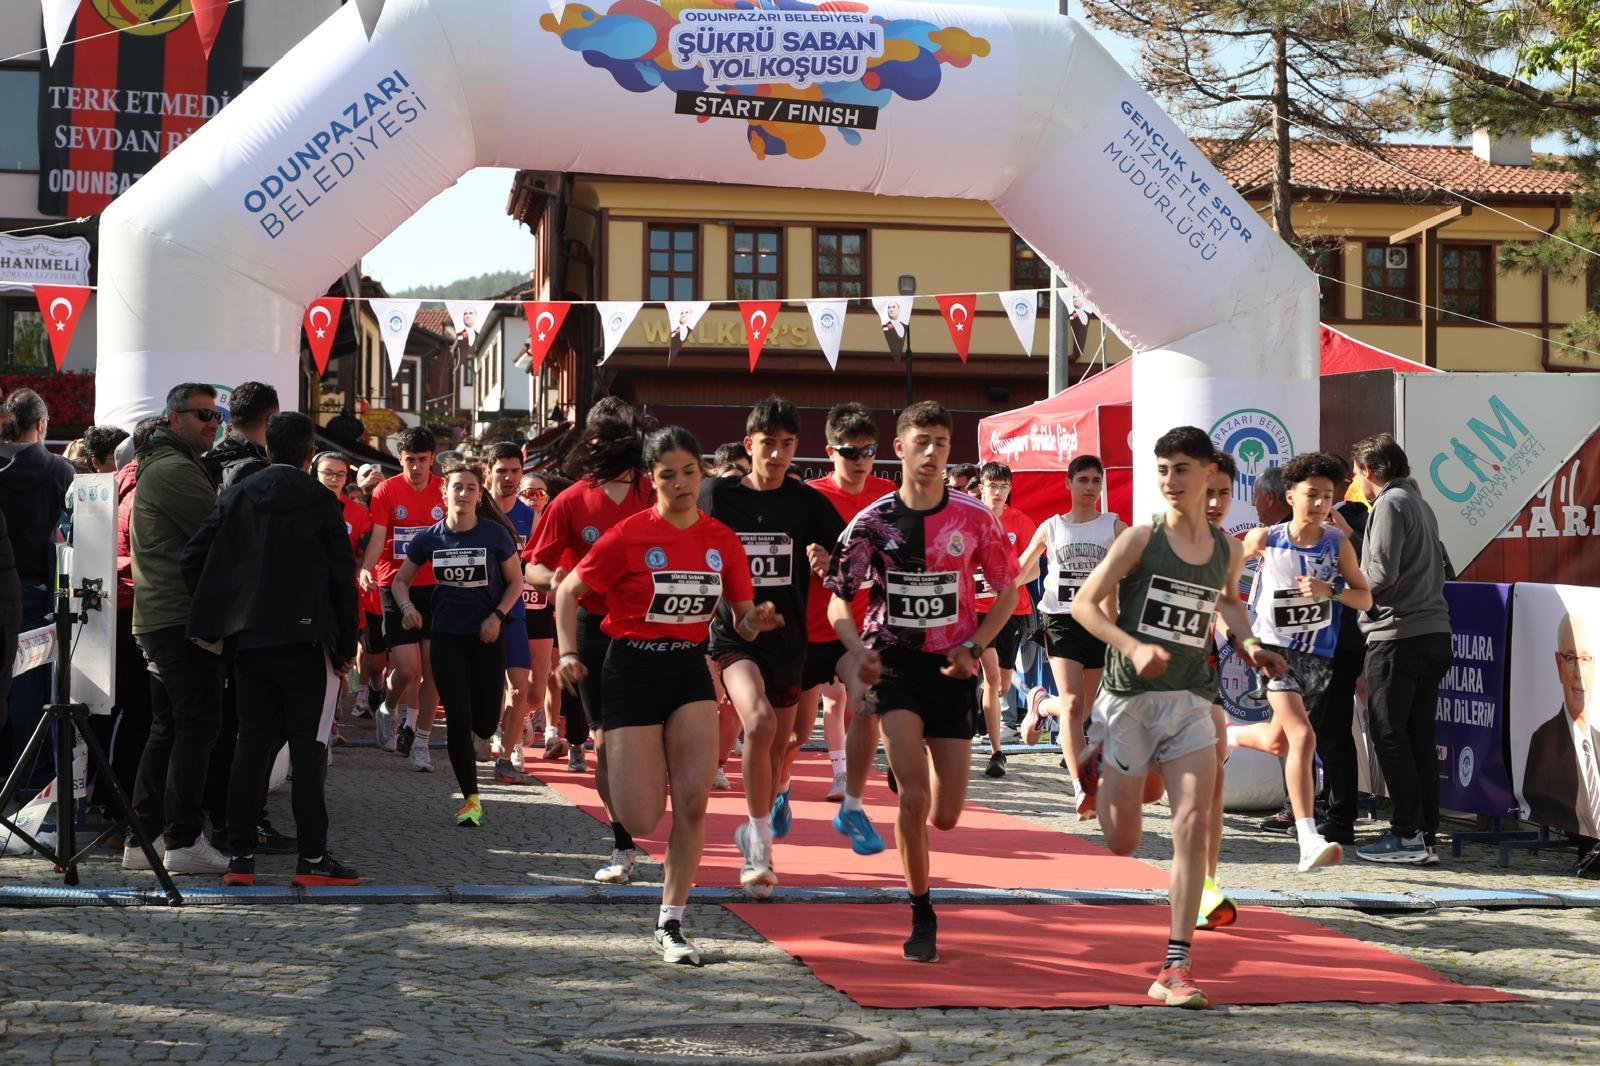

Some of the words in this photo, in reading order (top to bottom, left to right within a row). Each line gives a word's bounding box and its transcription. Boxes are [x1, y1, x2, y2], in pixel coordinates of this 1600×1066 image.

[685, 12, 781, 22] ODUNPAZARI
[785, 14, 864, 23] BELEDİYESİ
[678, 26, 774, 62] ŞÜKRÜ
[783, 31, 876, 51] SABAN
[709, 59, 755, 79] YOL
[760, 56, 858, 82] KOŞUSU
[48, 86, 120, 112] TERK
[694, 97, 764, 118] START
[788, 105, 860, 126] FINISH
[55, 125, 161, 153] SEVDAN
[244, 70, 409, 213] ODUNPAZARI
[260, 91, 427, 239] BELEDİYESİ
[1121, 100, 1187, 172] GENÇLİK
[1190, 171, 1211, 197] VE
[1211, 196, 1252, 243] SPOR
[49, 169, 144, 195] ODUNBA
[1123, 129, 1229, 241] HİZMETLERİ
[1103, 141, 1217, 260] MÜDÜRLÜĞÜ
[1, 257, 80, 271] HANIMELİ
[643, 319, 808, 347] WLKR'S
[1213, 415, 1253, 449] NPAZARI
[1469, 442, 1545, 526] ODUNPAZARI
[444, 567, 475, 581] 097
[751, 557, 778, 576] 01
[522, 591, 538, 603] 08
[664, 596, 705, 614] 095
[902, 597, 944, 618] 109
[1158, 606, 1201, 634] 114
[1286, 605, 1322, 625] 122
[627, 640, 668, 652] NIKE
[1451, 633, 1494, 662] CULARA
[1435, 697, 1451, 721] AR
